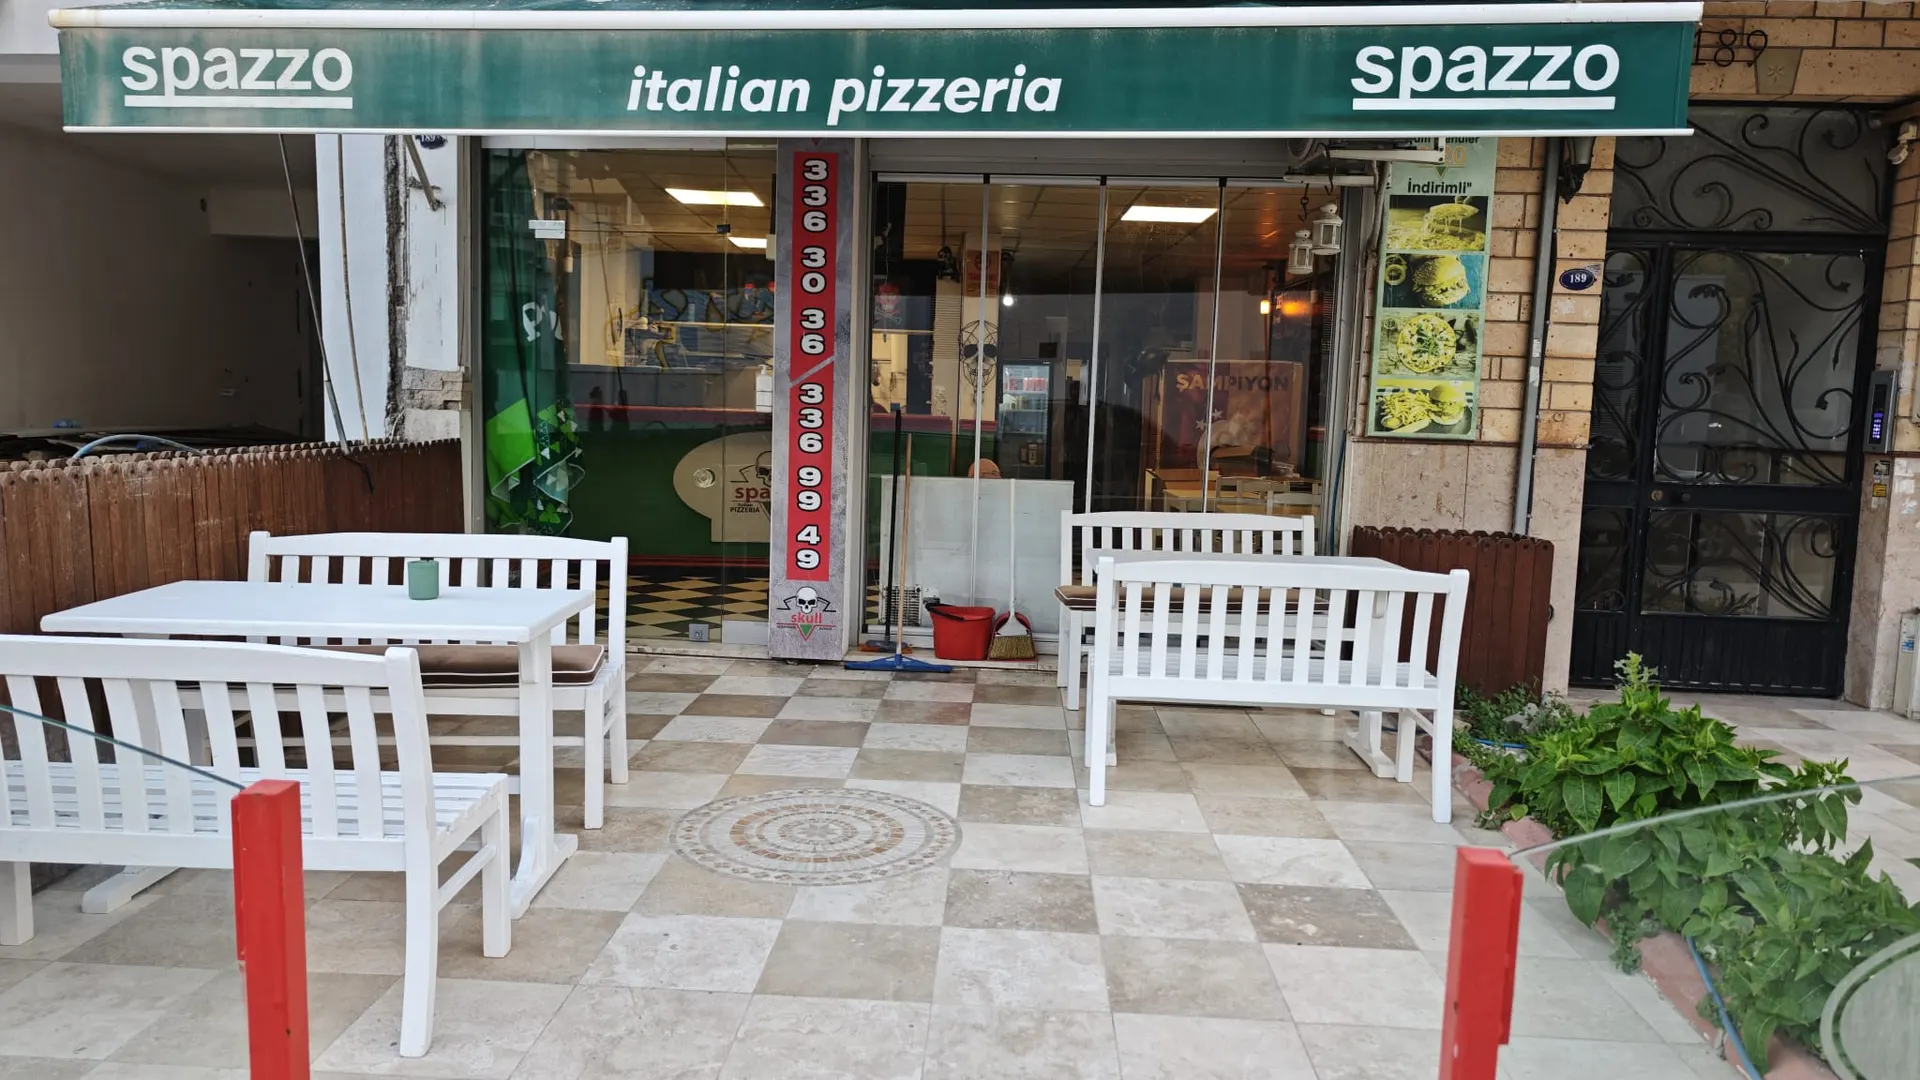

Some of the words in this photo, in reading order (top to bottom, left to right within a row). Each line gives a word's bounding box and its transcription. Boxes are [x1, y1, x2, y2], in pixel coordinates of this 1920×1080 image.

[1690, 28, 1768, 67] 189
[121, 46, 353, 98] spazzo
[627, 65, 810, 112] italian
[827, 64, 1062, 126] pizzeria
[1351, 44, 1620, 100] spazzo
[802, 159, 828, 232] 336
[1407, 178, 1472, 194] İndirimli"
[801, 247, 827, 293] 30
[1570, 273, 1587, 283] 189
[800, 308, 826, 354] 36
[798, 383, 824, 453] 336
[797, 466, 822, 511] 99
[796, 525, 821, 569] 49
[791, 611, 822, 624] skull
